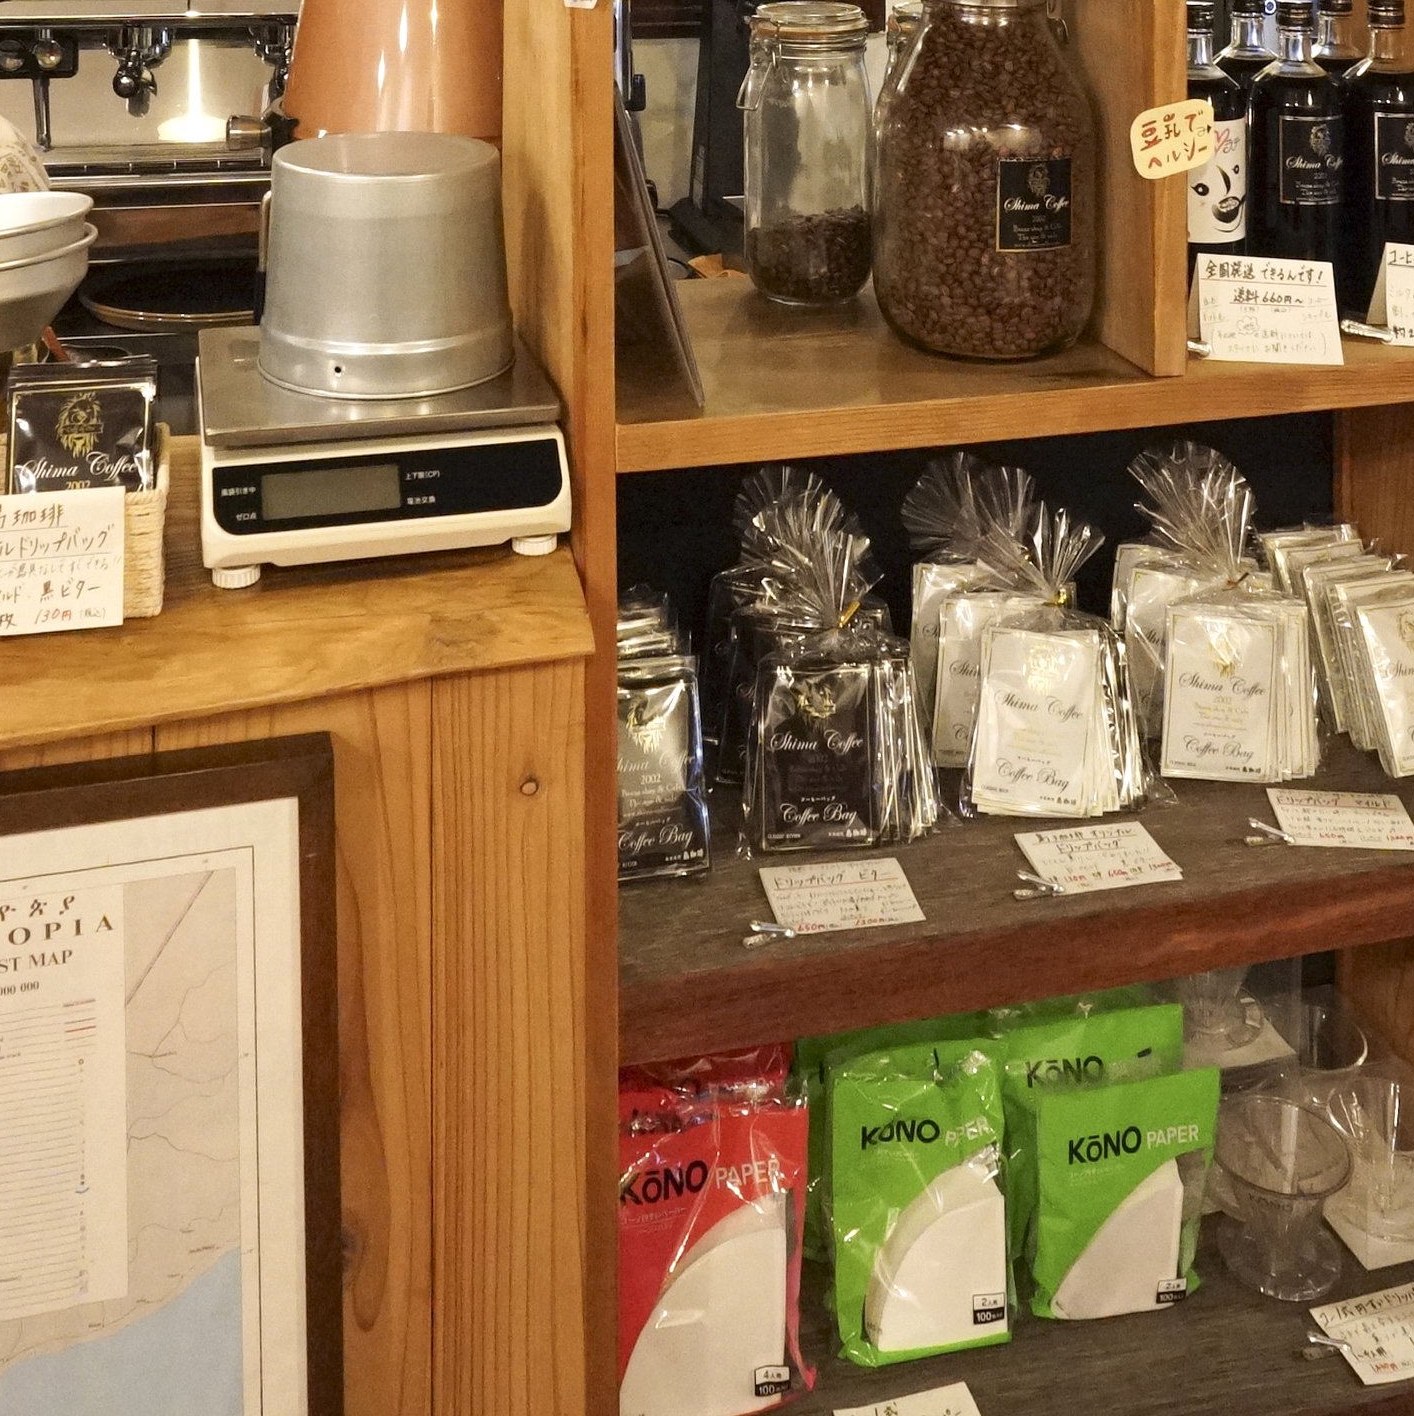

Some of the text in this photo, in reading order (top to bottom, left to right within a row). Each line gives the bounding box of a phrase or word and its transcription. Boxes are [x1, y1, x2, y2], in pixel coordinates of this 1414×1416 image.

[1141, 110, 1205, 153] 豆乳で
[1147, 141, 1209, 170] ヘルシー
[1286, 155, 1321, 169] Shima
[1004, 197, 1039, 213] Shima
[20, 451, 140, 480] Shima Coffee
[40, 578, 101, 603] 黒ビター
[35, 608, 71, 624] 130円
[1179, 672, 1266, 698] Shima Coffee
[994, 690, 1084, 723] Shima Coffee
[770, 729, 863, 755] Shima Coffee
[1183, 736, 1254, 762] Coffee Bag
[641, 774, 661, 785] 2002
[996, 758, 1070, 792] Coffee Bag
[779, 802, 857, 825] Coffee Bag
[618, 825, 693, 855] Coffee Bag
[29, 949, 73, 970] MAP
[1147, 1125, 1200, 1150] PAPER
[715, 1160, 780, 1189] PAPER
